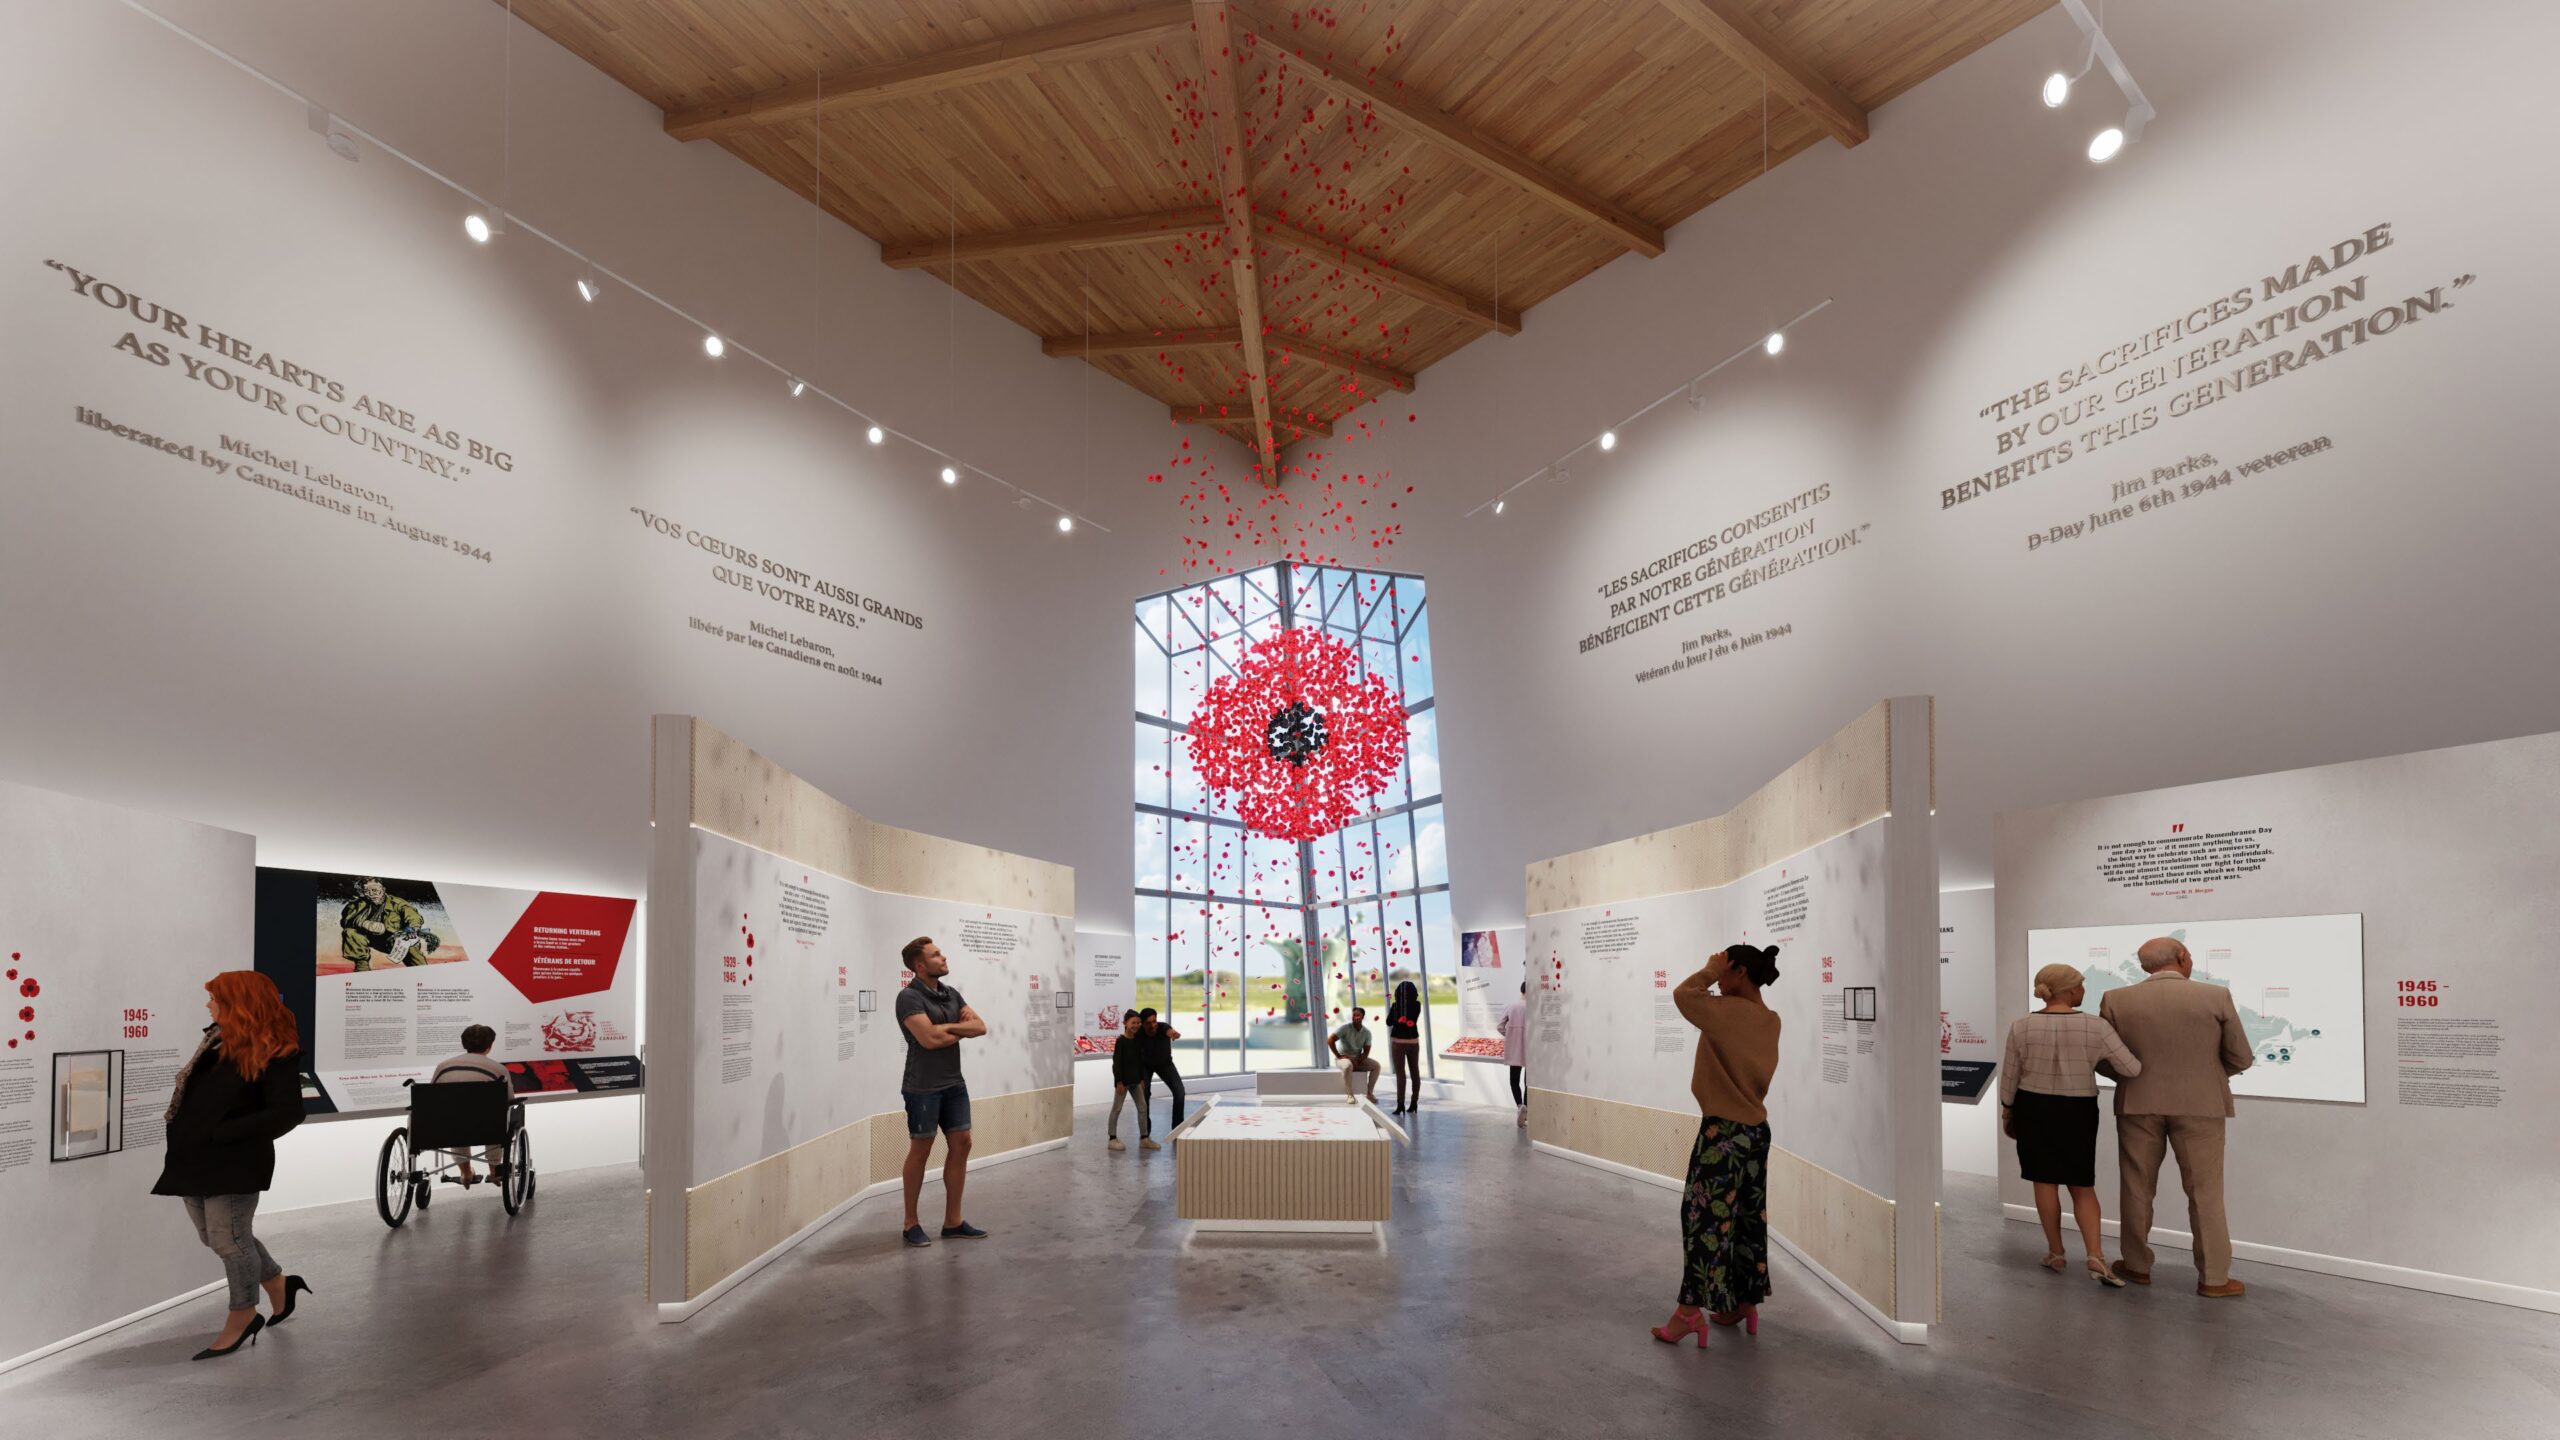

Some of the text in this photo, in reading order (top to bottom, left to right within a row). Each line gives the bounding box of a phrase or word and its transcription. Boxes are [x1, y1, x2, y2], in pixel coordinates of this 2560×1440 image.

[1978, 222, 2394, 422] “THE SACRIFICES MADE
[43, 259, 514, 472] “YOUR HEARTS ARE AS BIG
[113, 332, 170, 366] AS
[178, 353, 288, 415] YOUR
[1996, 276, 2368, 455] BY OUR GENERATION
[75, 406, 492, 563] liberated by Canadians in August 1944
[219, 434, 395, 511] Michel Lebaron,
[1940, 440, 2073, 510] BENEFITS
[2080, 408, 2159, 453] THIS
[2027, 432, 2333, 551] D-Day June 6th 1944 veteran
[2110, 451, 2219, 502] Jim Parks,
[630, 506, 923, 630] “VOS CŒURS SONT AUSSI GRANDS
[1598, 483, 1831, 599] “LES SACRIFICES CONSENTIS
[1610, 518, 1815, 618] PAR NOTRE GÉNÉRATION
[712, 565, 752, 591] QUE
[756, 580, 815, 613] VOTRE
[1579, 606, 1670, 654] BÉNÉFICIENT
[1673, 584, 1725, 616] CETTE
[689, 617, 882, 686] libéré par les Canadiens en août 1944
[750, 621, 835, 657] Michel Lebaron,
[1635, 623, 1792, 683] Vétéran du Jour J du 6 Juin 1944
[1682, 629, 1732, 654] Jim Parks,
[123, 1008, 148, 1022] 1945
[2397, 980, 2437, 992] 1945
[2397, 995, 2438, 1007] 1960
[123, 1025, 148, 1039] 1960
